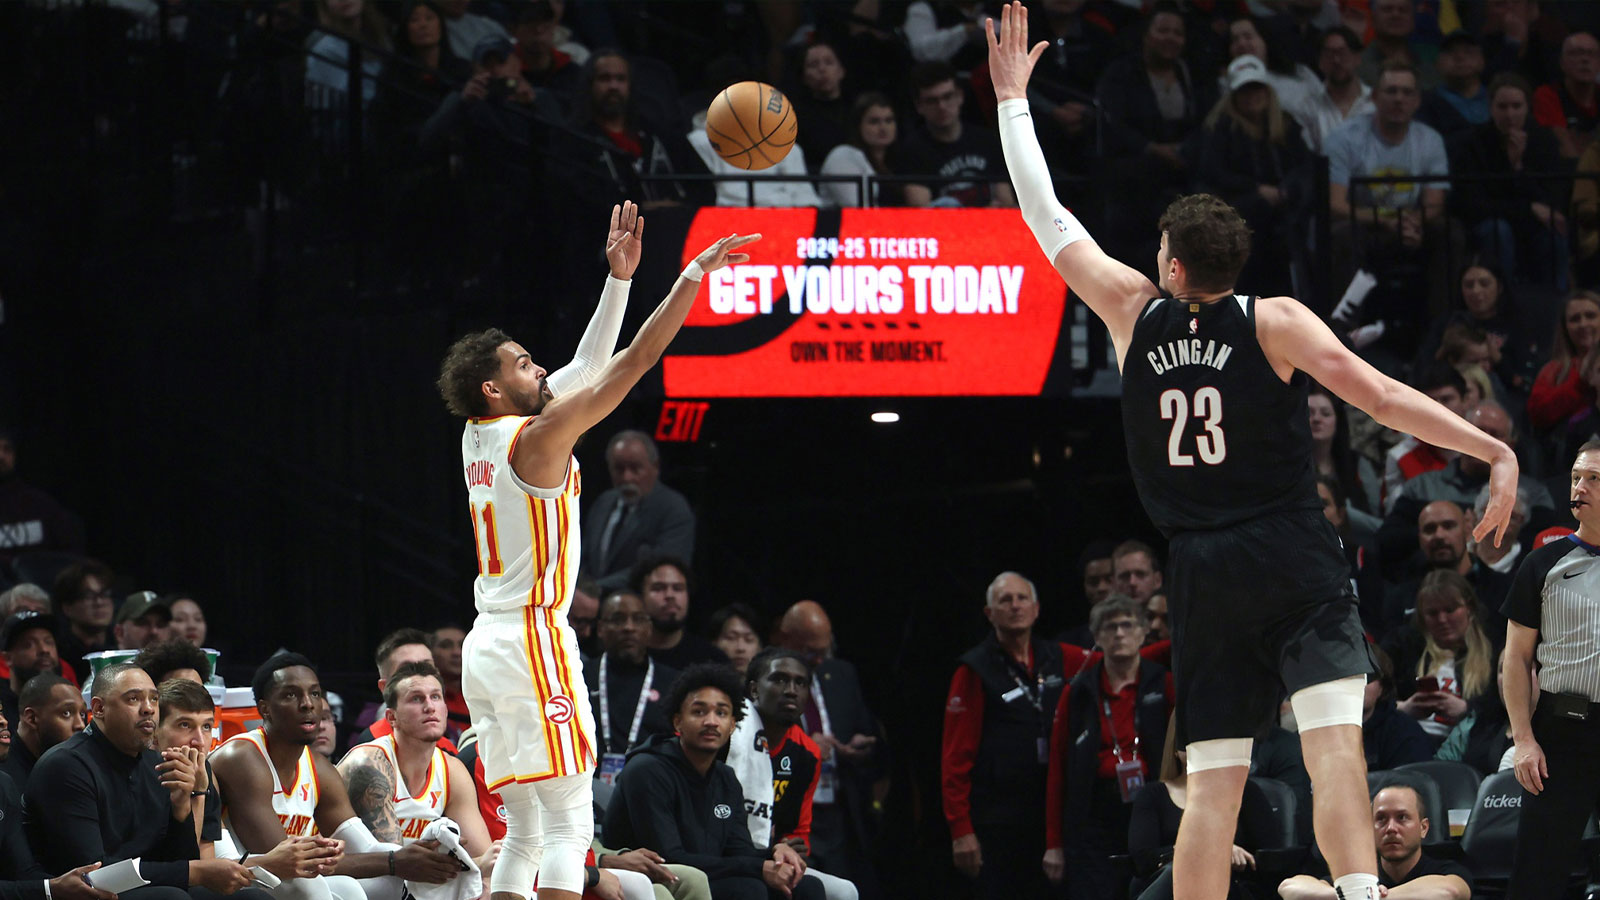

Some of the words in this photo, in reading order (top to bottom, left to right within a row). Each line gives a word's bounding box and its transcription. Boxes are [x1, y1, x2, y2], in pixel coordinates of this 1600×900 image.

[797, 237, 866, 259] 2024-25
[869, 238, 939, 259] TICKETS
[709, 265, 778, 314] GET
[784, 265, 903, 314] YOURS
[909, 265, 1024, 314] TODAY
[791, 341, 828, 362] OWN
[835, 341, 865, 362] THE
[870, 341, 947, 362] MOMENT.
[1147, 338, 1233, 376] CLINGAN
[655, 401, 709, 441] EXIT
[1160, 386, 1226, 467] 23
[466, 460, 495, 489] YOUNG
[470, 501, 504, 577] 11
[1483, 794, 1522, 809] ticket
